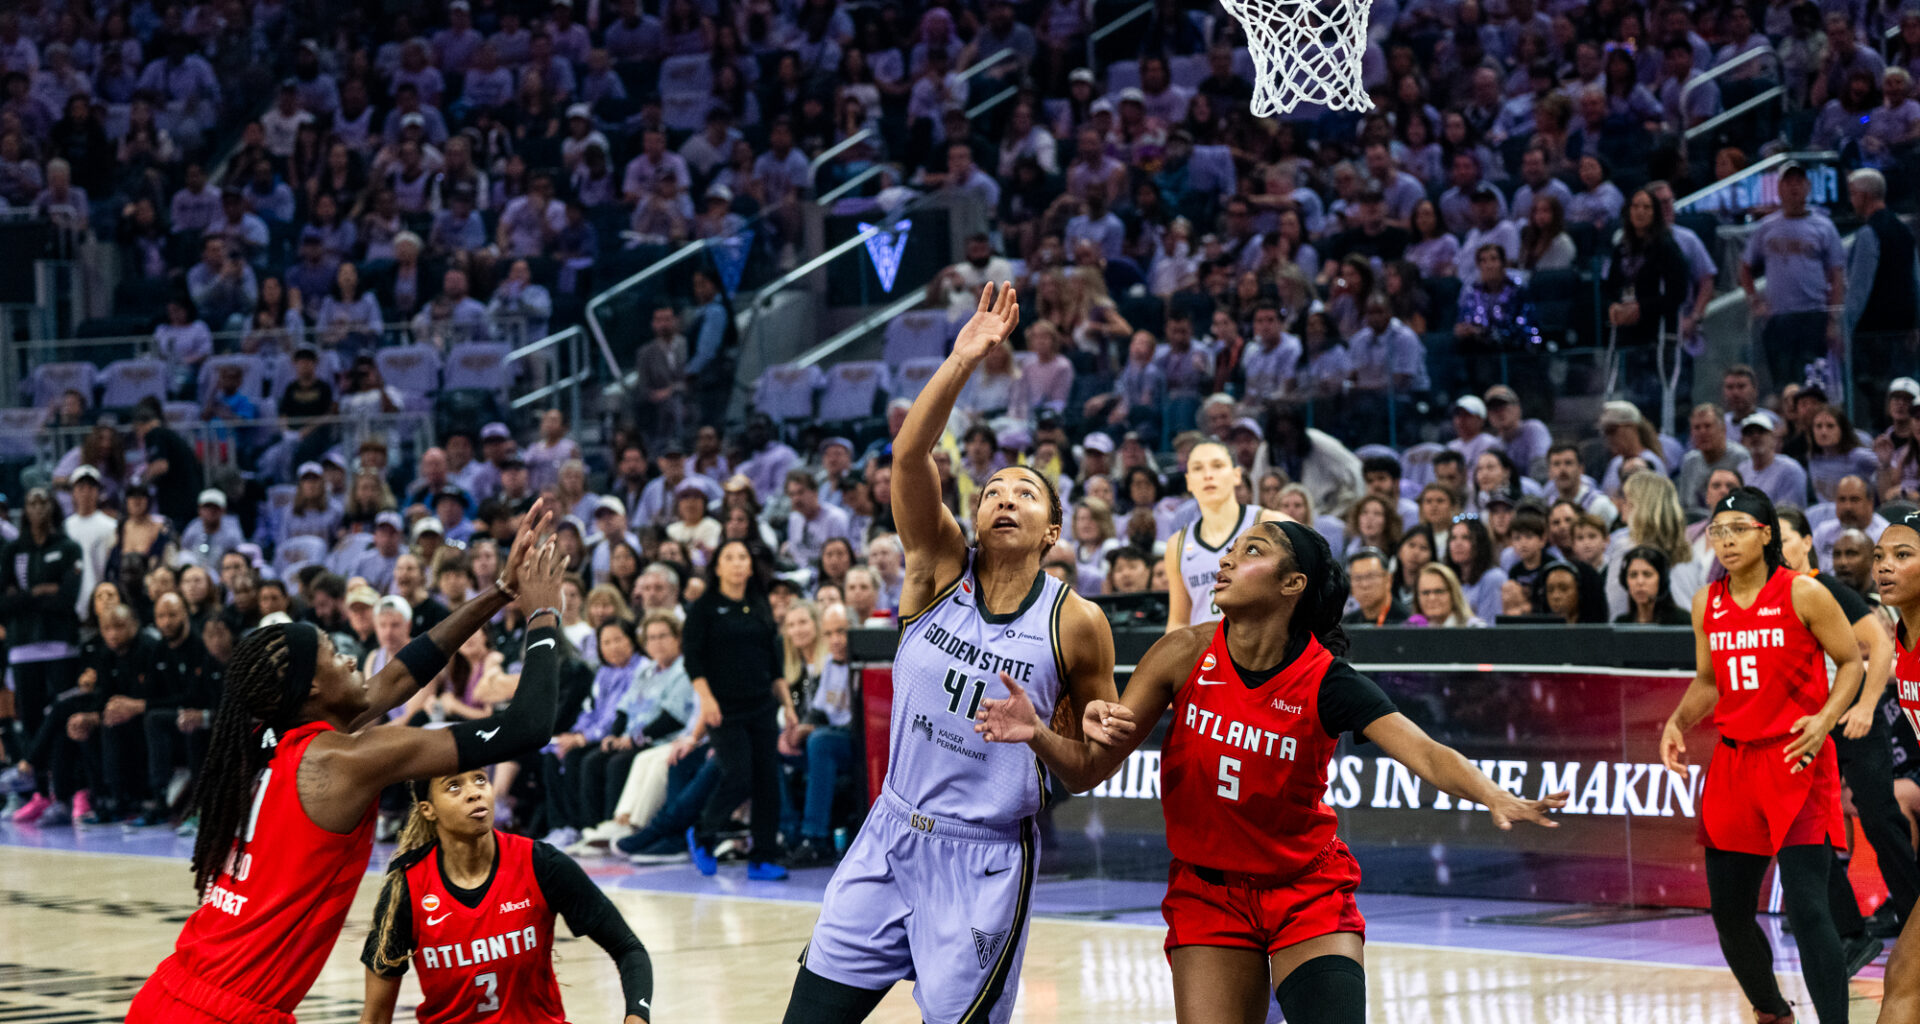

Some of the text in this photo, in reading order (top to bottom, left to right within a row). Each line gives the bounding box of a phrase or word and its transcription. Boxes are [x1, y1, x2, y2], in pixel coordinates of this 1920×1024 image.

[1757, 606, 1781, 616] Albert
[924, 622, 1034, 683] GOLDEN STATE
[1709, 628, 1784, 651] ATLANTA
[1727, 655, 1759, 691] 15
[942, 666, 987, 720] 41
[1270, 698, 1303, 715] Albert
[938, 728, 965, 744] KAISER
[1185, 702, 1297, 761] ATLANTA
[936, 738, 988, 761] PERMANENTE
[1217, 755, 1241, 801] 5
[1371, 757, 1421, 809] IN
[1537, 761, 1705, 818] MAKIN
[910, 813, 936, 833] GSV
[209, 886, 249, 917] AT&T
[499, 898, 531, 914] Albert
[422, 925, 538, 969] ATLANTA
[474, 972, 500, 1013] 3
